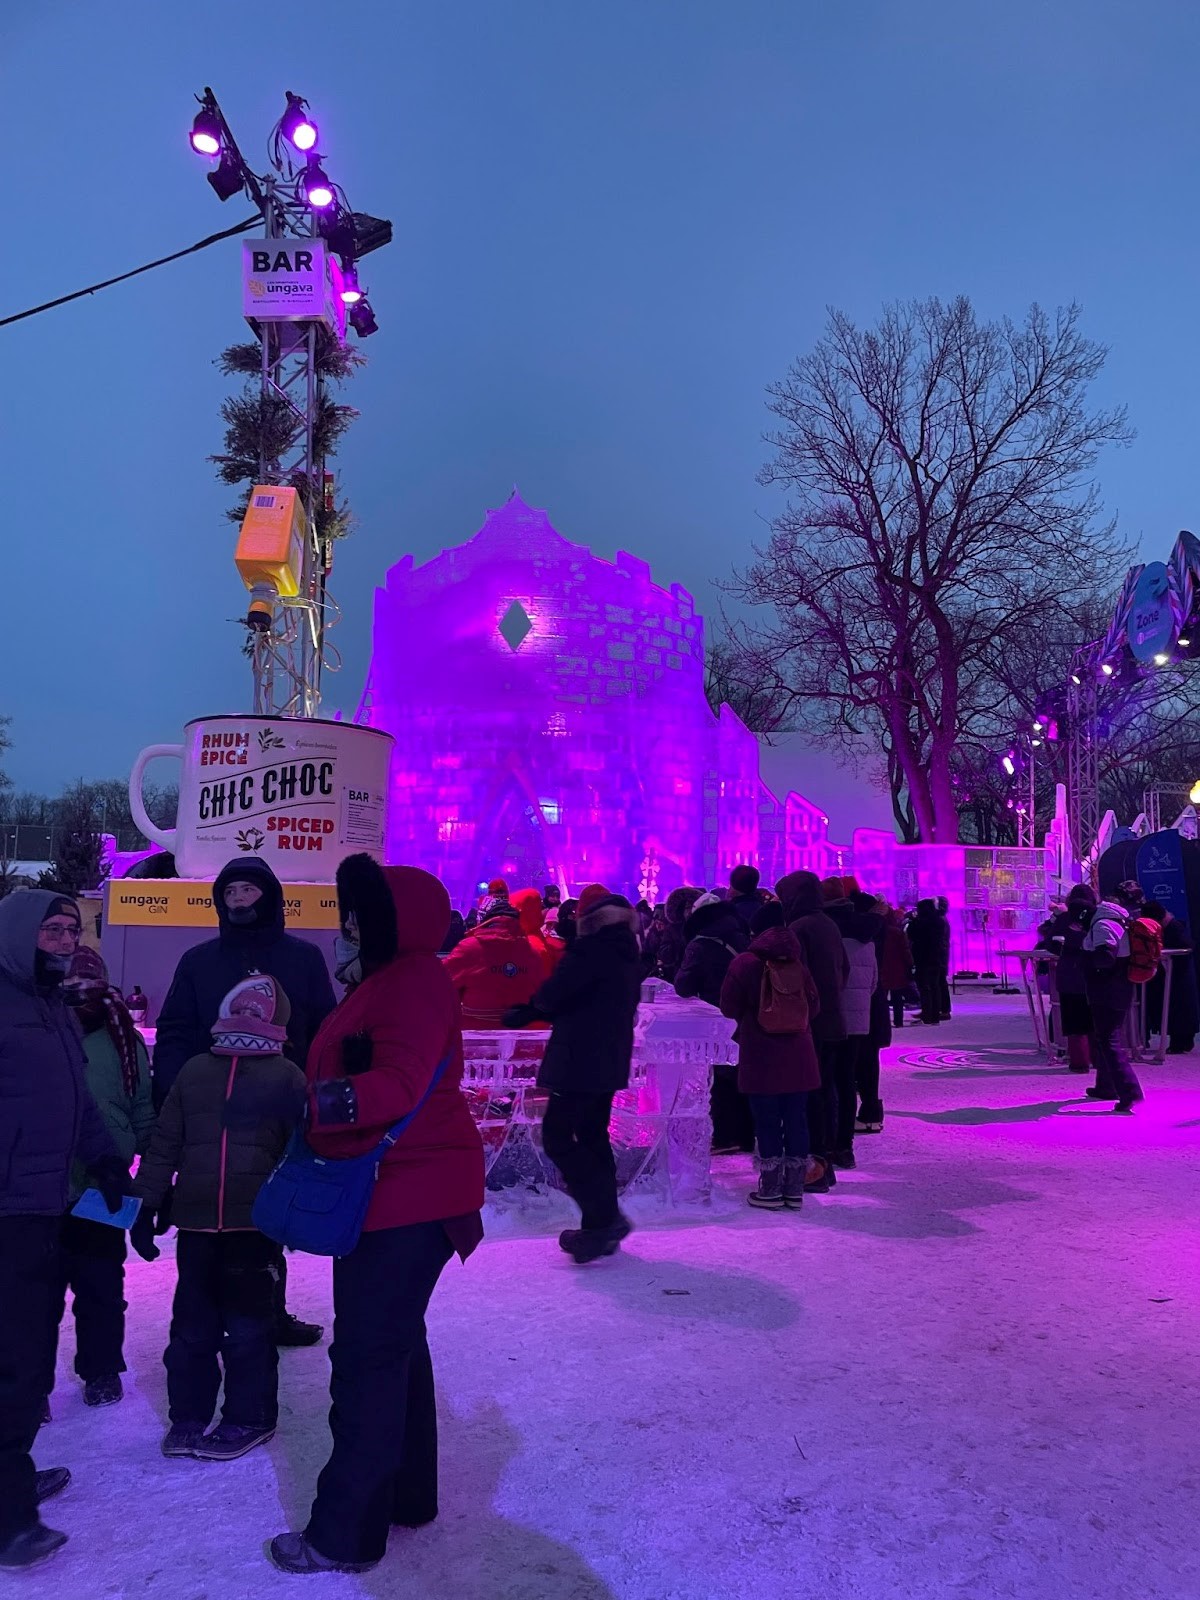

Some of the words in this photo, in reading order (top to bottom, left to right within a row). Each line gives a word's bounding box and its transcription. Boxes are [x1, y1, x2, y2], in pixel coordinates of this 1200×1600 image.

[252, 251, 313, 272] BAR
[267, 284, 313, 295] ungava
[1136, 610, 1160, 630] Zone
[202, 732, 249, 749] RHUM
[199, 776, 254, 820] CHIC
[261, 762, 333, 804] CHOC
[348, 790, 369, 802] BAR
[267, 816, 334, 834] SPICED
[278, 835, 323, 851] RUM
[120, 895, 168, 907] ungava
[149, 905, 168, 914] GIN
